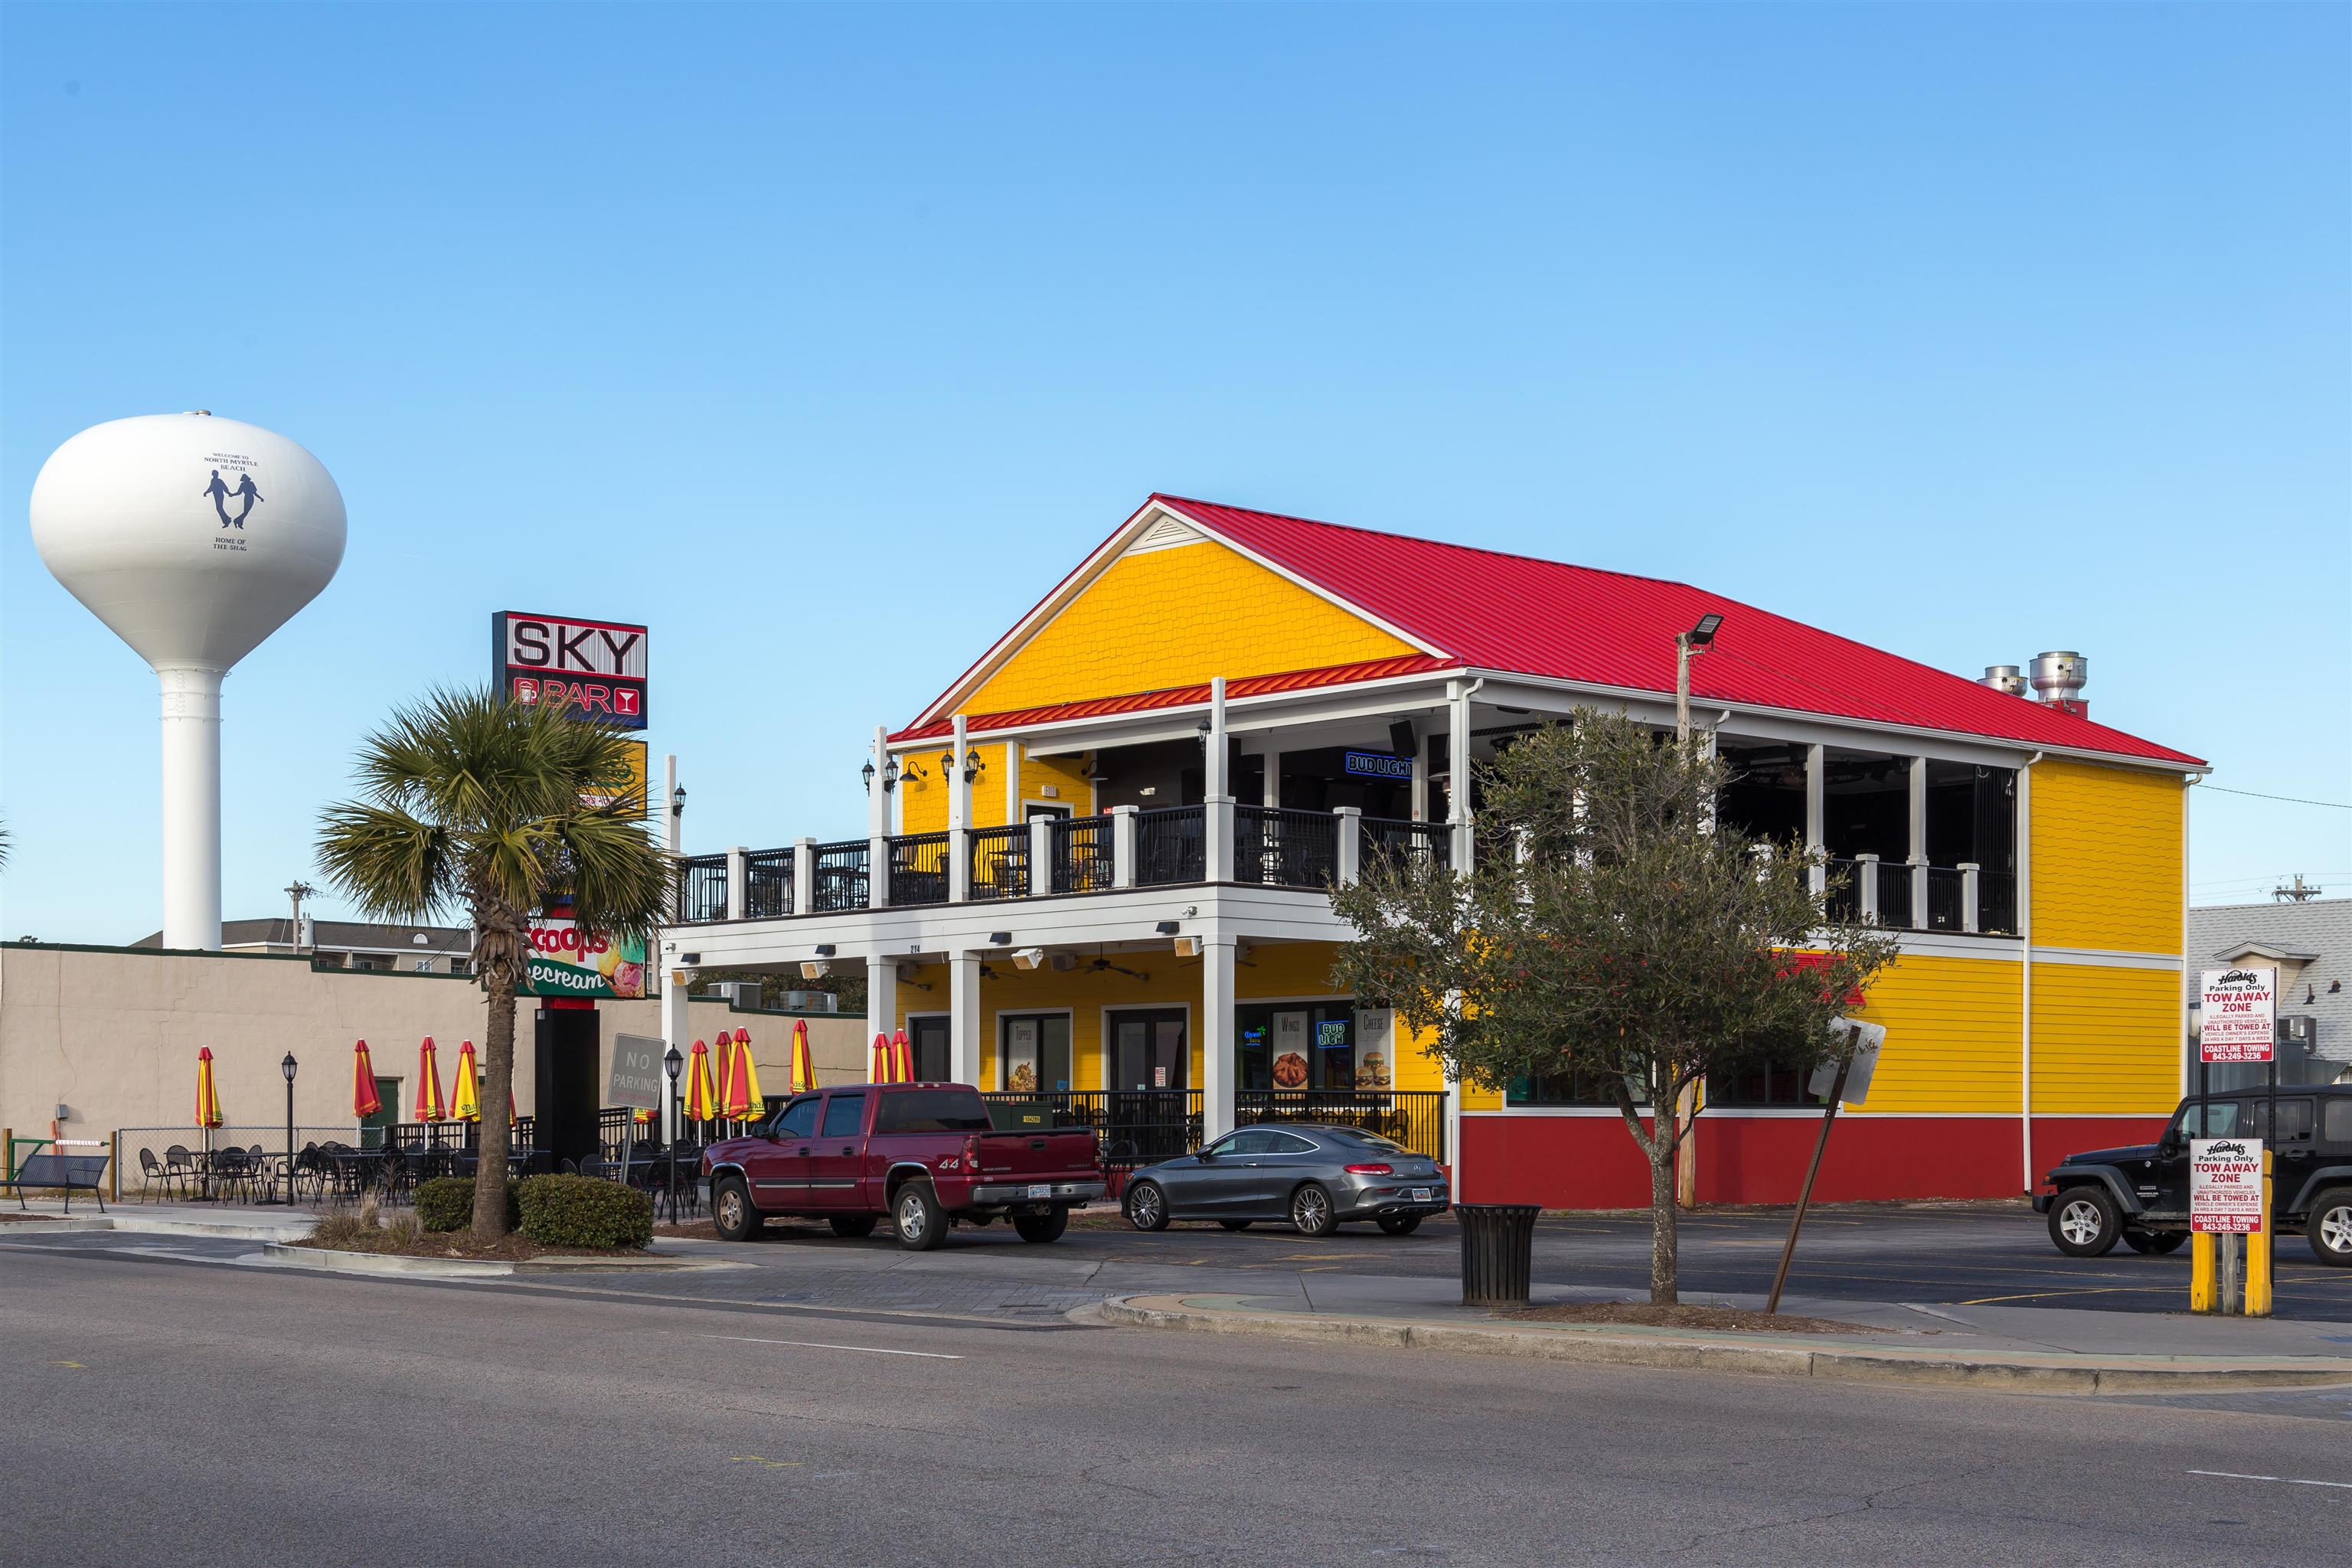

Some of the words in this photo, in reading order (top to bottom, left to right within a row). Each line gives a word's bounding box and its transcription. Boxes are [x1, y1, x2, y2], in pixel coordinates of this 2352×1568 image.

[514, 621, 639, 675] SKY
[544, 679, 612, 714] BAR
[1348, 756, 1376, 772] BUD
[525, 927, 609, 962] coops
[910, 945, 920, 953] 214
[2205, 993, 2234, 1002] TOW
[2235, 992, 2270, 1001] AWAY
[2223, 1003, 2251, 1012] ZONE
[1323, 1024, 1344, 1034] BUD
[1319, 1034, 1344, 1045] LIGH
[2204, 1044, 2241, 1053] COASTLINE
[626, 1052, 649, 1070] NO
[613, 1074, 658, 1092] PARKING
[2194, 1164, 2223, 1172] TOW
[2223, 1164, 2259, 1172] AWAY
